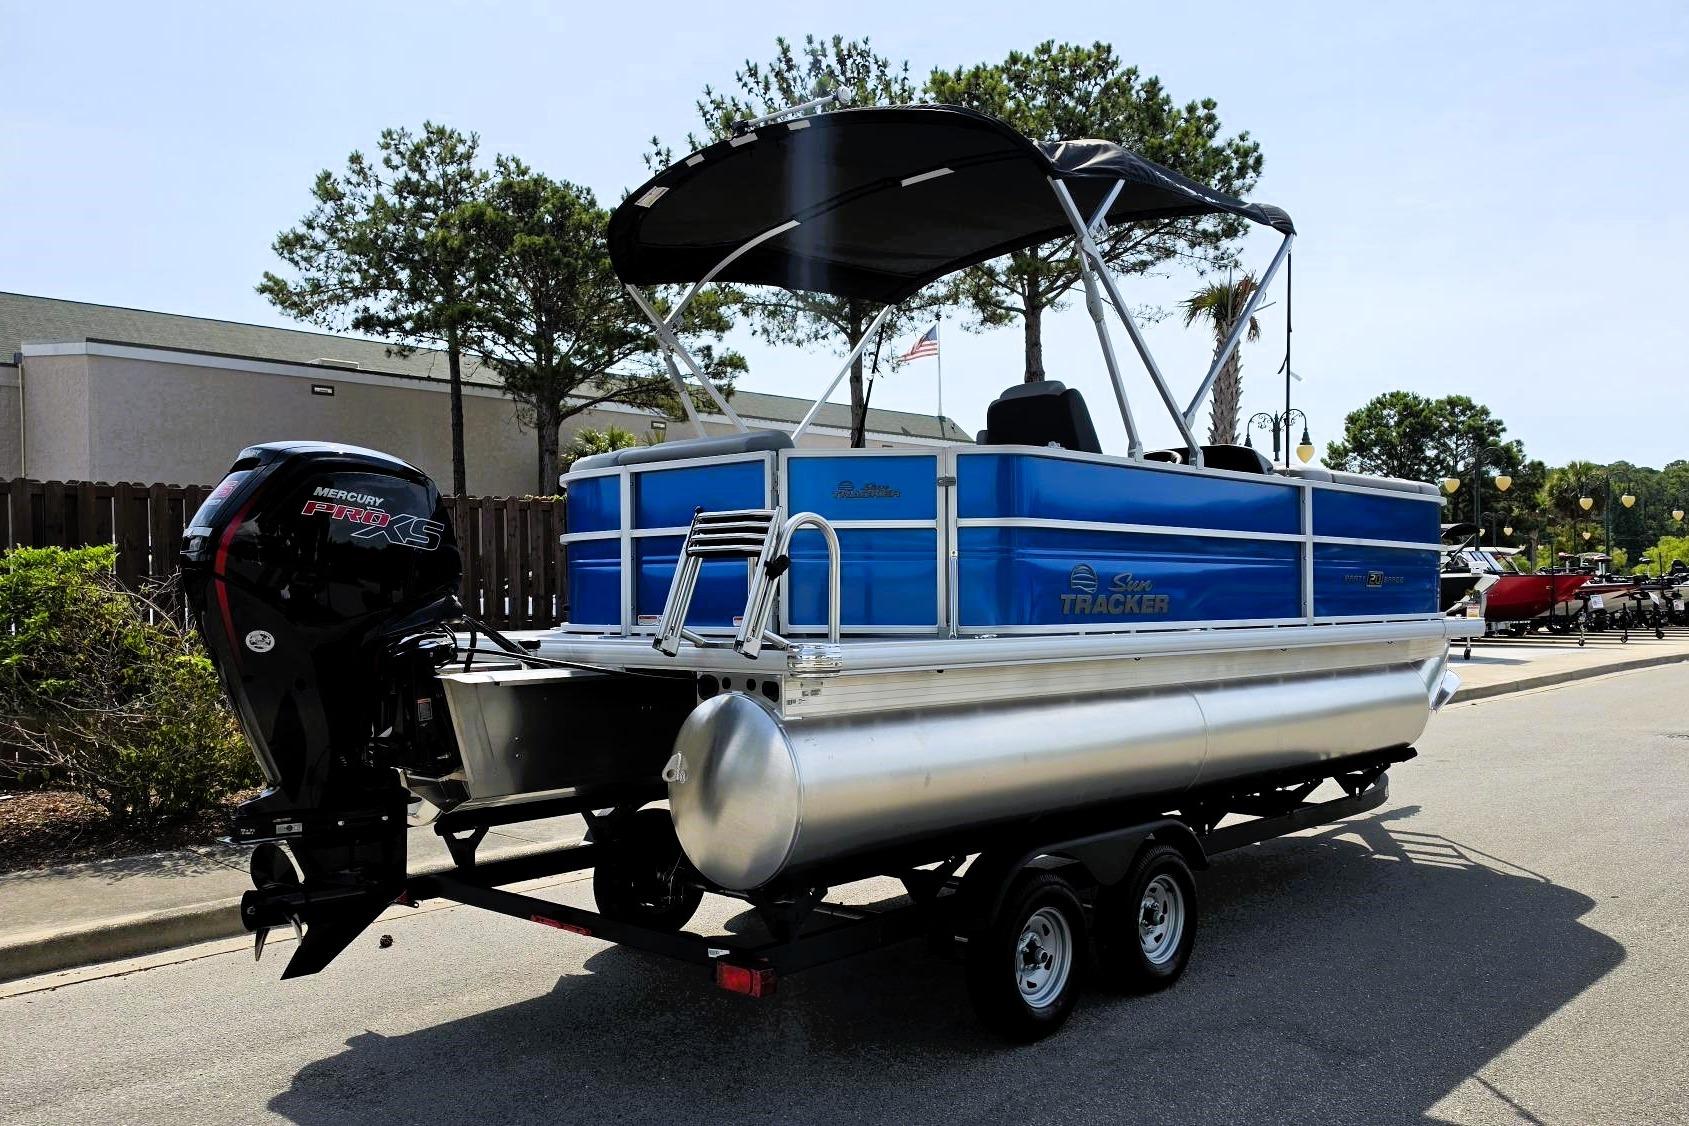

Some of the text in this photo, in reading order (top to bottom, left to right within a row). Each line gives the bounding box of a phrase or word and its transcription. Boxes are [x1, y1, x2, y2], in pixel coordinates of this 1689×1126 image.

[313, 486, 385, 507] MERCURY
[301, 500, 445, 551] PRO XS
[1108, 572, 1153, 592] Sun
[1060, 593, 1169, 614] TRACKER
